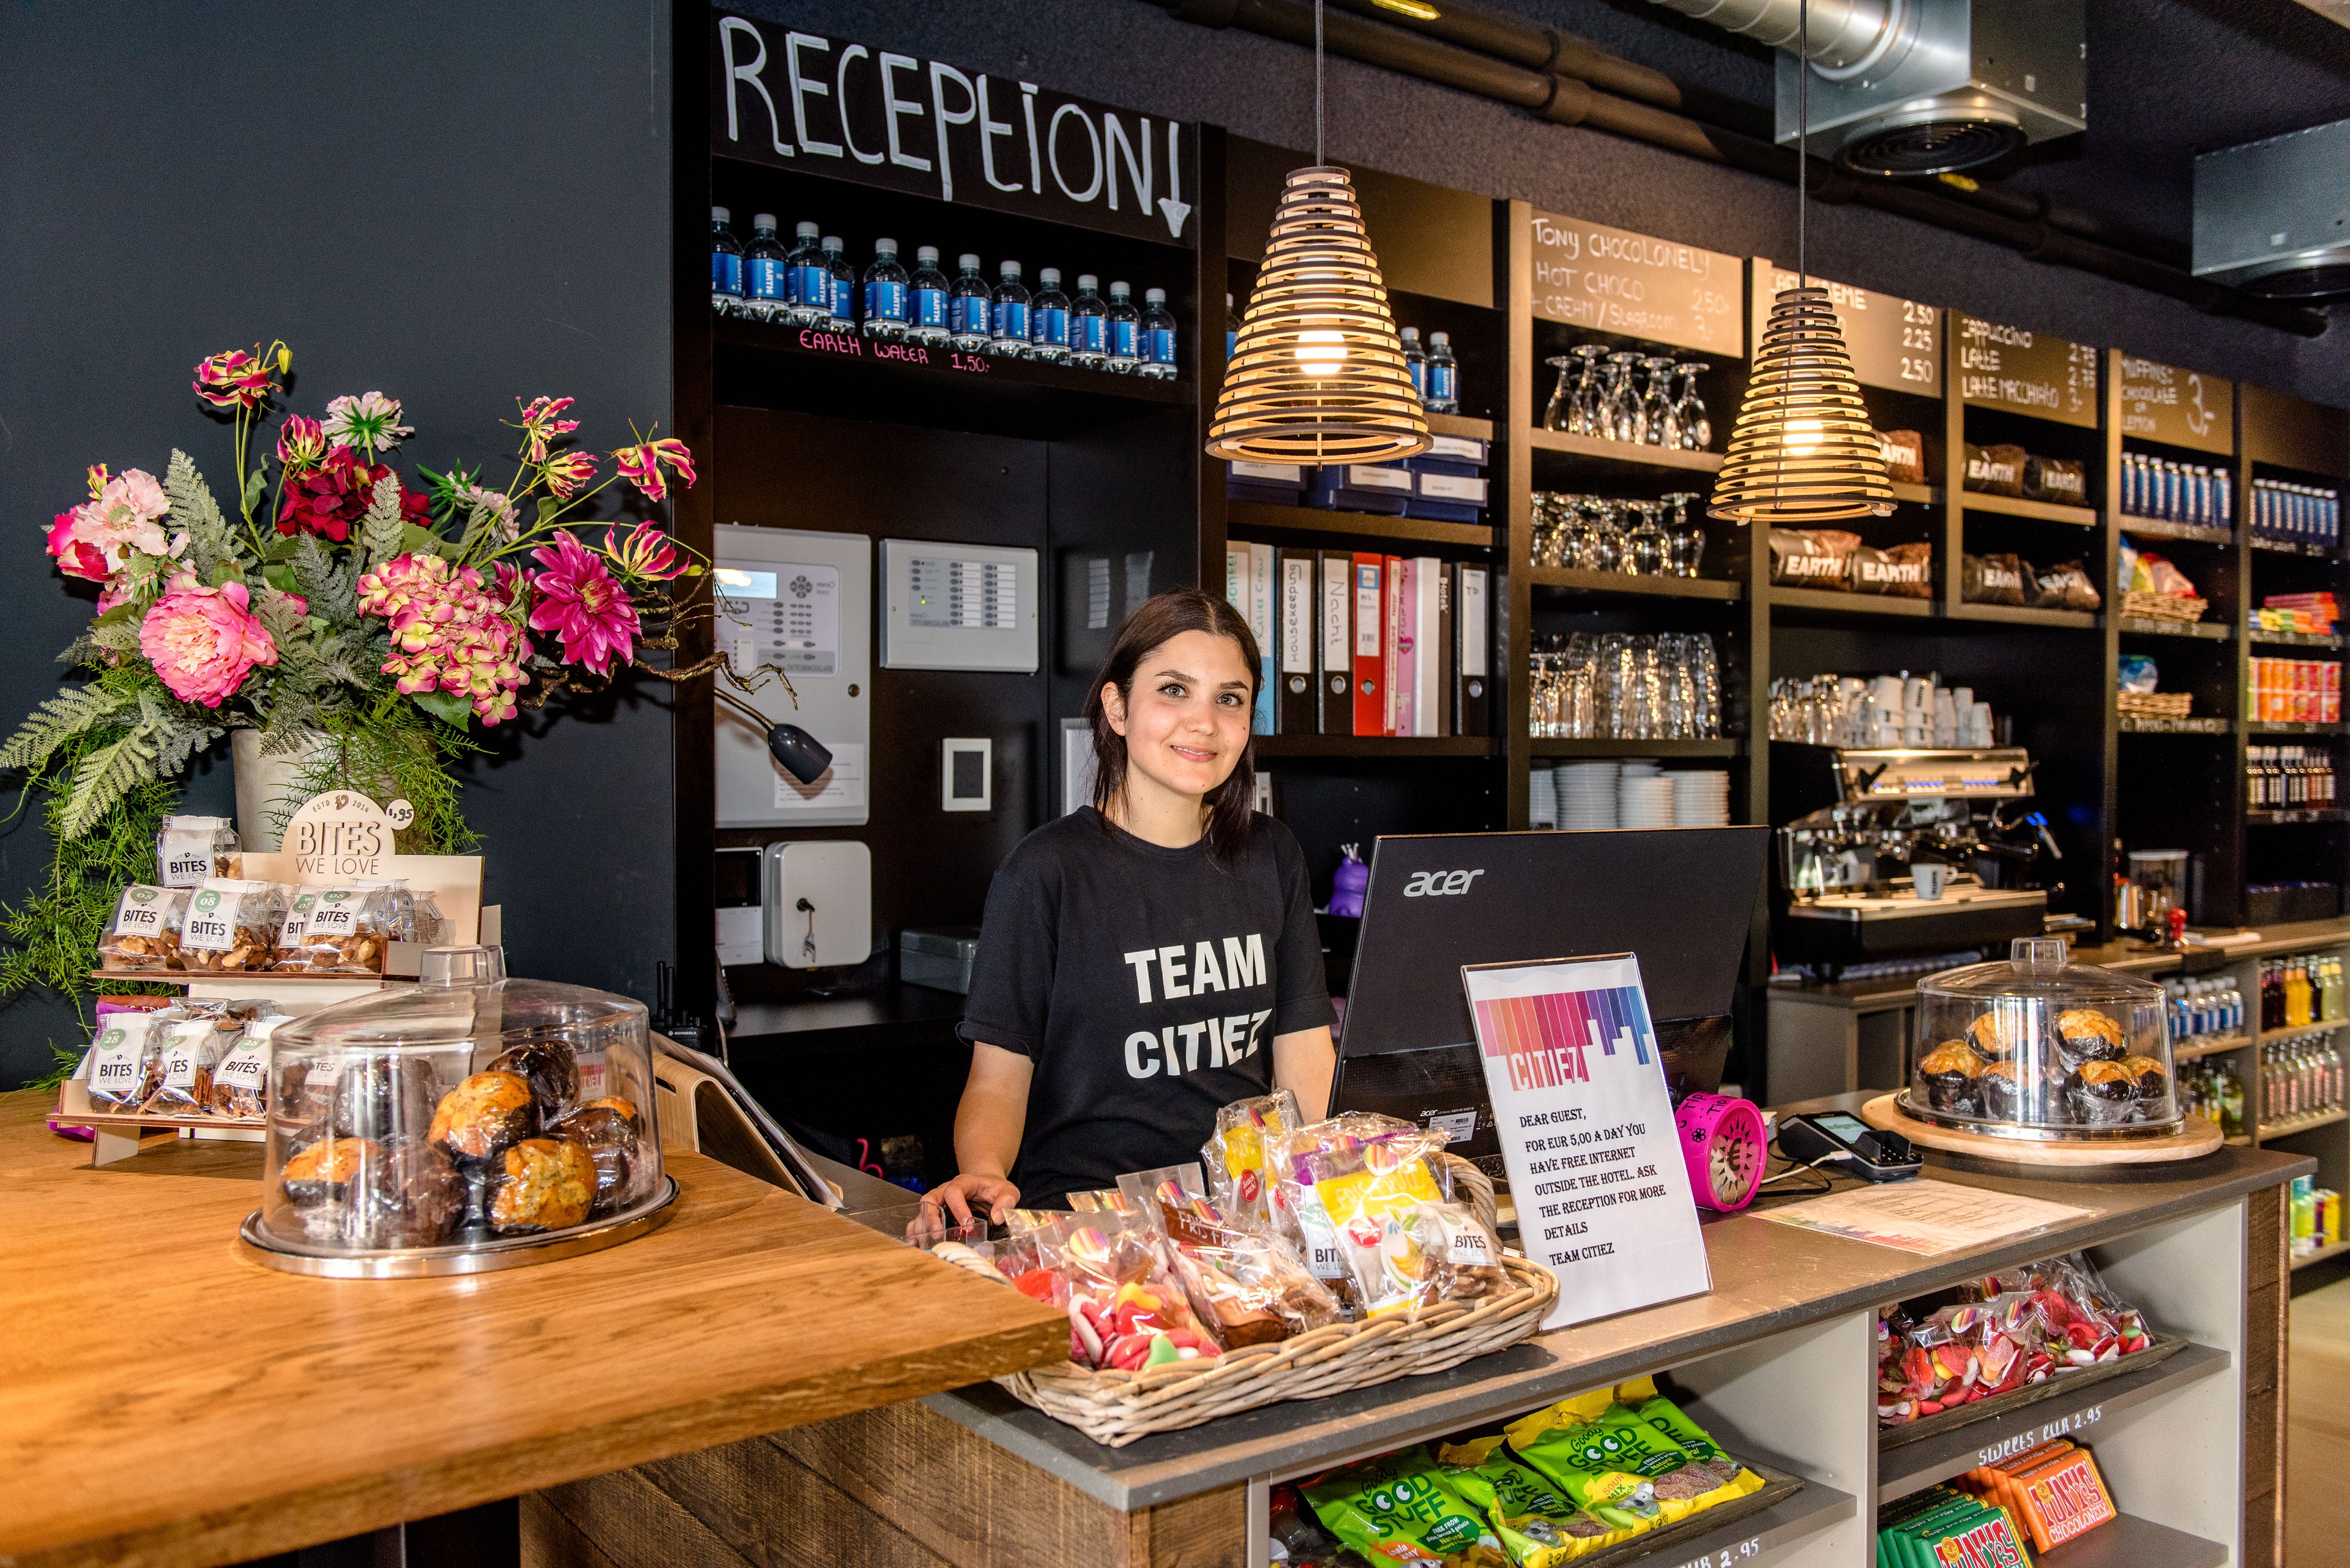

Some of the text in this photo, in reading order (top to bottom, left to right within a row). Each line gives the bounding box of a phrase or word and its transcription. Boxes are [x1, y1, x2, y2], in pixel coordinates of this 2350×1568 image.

[1588, 233, 1710, 282] CHOCOLONELY
[765, 261, 774, 295] EARTH
[1536, 261, 1645, 302] HOT CHOCO
[1544, 295, 1593, 319] CREAM
[800, 329, 861, 356] EARTH
[1969, 459, 2015, 483] EARTH
[1785, 554, 1842, 577] EARTH
[1862, 562, 1921, 583] EARTH
[1330, 580, 1345, 646] Nacht
[313, 800, 370, 813] ESTD 2014
[389, 808, 414, 821] 1,95
[296, 821, 381, 857] BITES
[170, 861, 207, 874] BITES
[296, 858, 379, 875] WE LOVE
[1403, 869, 1485, 897] acer
[200, 897, 217, 906] 08
[123, 909, 157, 924] BITES
[316, 911, 351, 923] BITES
[327, 922, 347, 930] LOVE
[191, 920, 226, 936] BITES
[206, 935, 225, 943] LOVE
[288, 922, 304, 935] BIT
[1124, 933, 1267, 1004] TEAM
[106, 1035, 120, 1043] 28
[1124, 1008, 1273, 1079] CITIEZ
[100, 1064, 132, 1077] BITES
[225, 1061, 261, 1074] BITES
[236, 1072, 256, 1081] LOVE
[1510, 1047, 1585, 1091] CITIEZ
[1520, 1108, 1587, 1128] DEAR GUEST,
[1525, 1122, 1646, 1152] FOR EUR 5,00 A DAY YOU
[1530, 1146, 1636, 1174] HAVE FREE INTERNET
[1242, 1173, 1255, 1190] Snack
[1534, 1164, 1658, 1197] OUTSIDE THE HOTEL. ASK
[1539, 1184, 1668, 1219] THE RECEPTION FOR MORE
[1544, 1221, 1589, 1241] DETAILS
[1453, 1248, 1467, 1256] WE
[1454, 1236, 1486, 1249] BITES
[1315, 1248, 1340, 1263] BIT
[1549, 1242, 1616, 1266] TEAM CITIEZ
[2074, 1405, 2102, 1430] 2.95
[1567, 1427, 1638, 1468] GOOD
[1571, 1427, 1605, 1453] Goody
[1582, 1439, 1652, 1476] STUFF
[1650, 1456, 1674, 1470] Natural
[1355, 1473, 1433, 1515] GOOD
[1361, 1470, 1398, 1498] Goody
[1603, 1473, 1625, 1495] SOUR
[1606, 1484, 1627, 1501] MIX
[1371, 1490, 1447, 1538] STUFF
[2048, 1503, 2111, 1545] CHOCOLONELY
[1432, 1516, 1460, 1535] FREE FROM
[1439, 1531, 1465, 1545] Natural
[1720, 1537, 1759, 1568] 2.95
